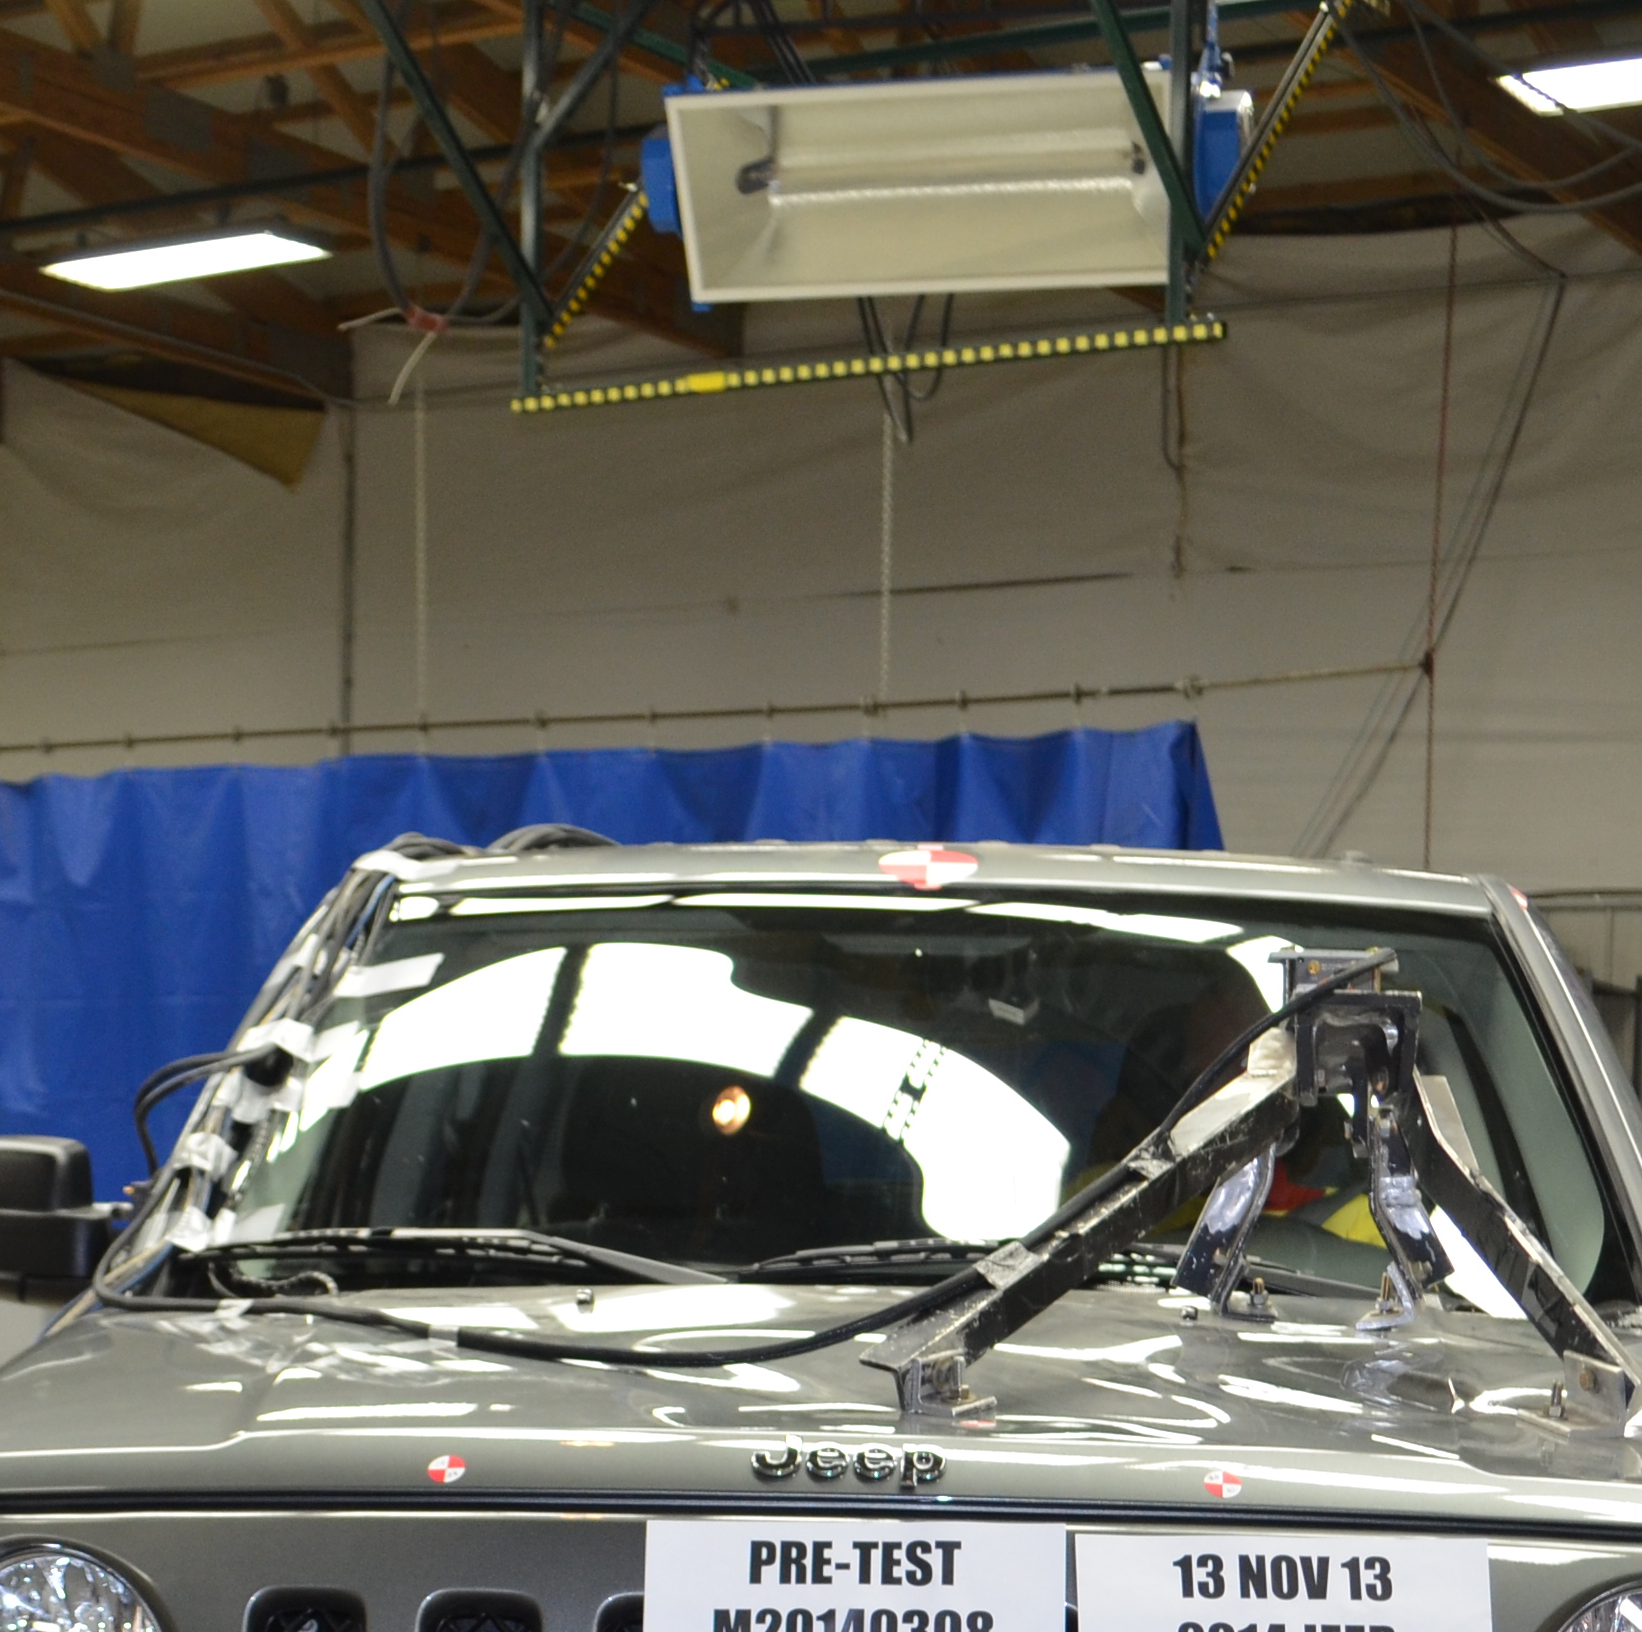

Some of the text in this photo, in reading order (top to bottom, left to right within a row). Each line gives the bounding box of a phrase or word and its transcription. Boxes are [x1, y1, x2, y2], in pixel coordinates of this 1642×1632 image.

[751, 1434, 946, 1489] Jeep
[750, 1541, 961, 1586] PRE-TEST
[1173, 1555, 1392, 1600] 13 NOV 13
